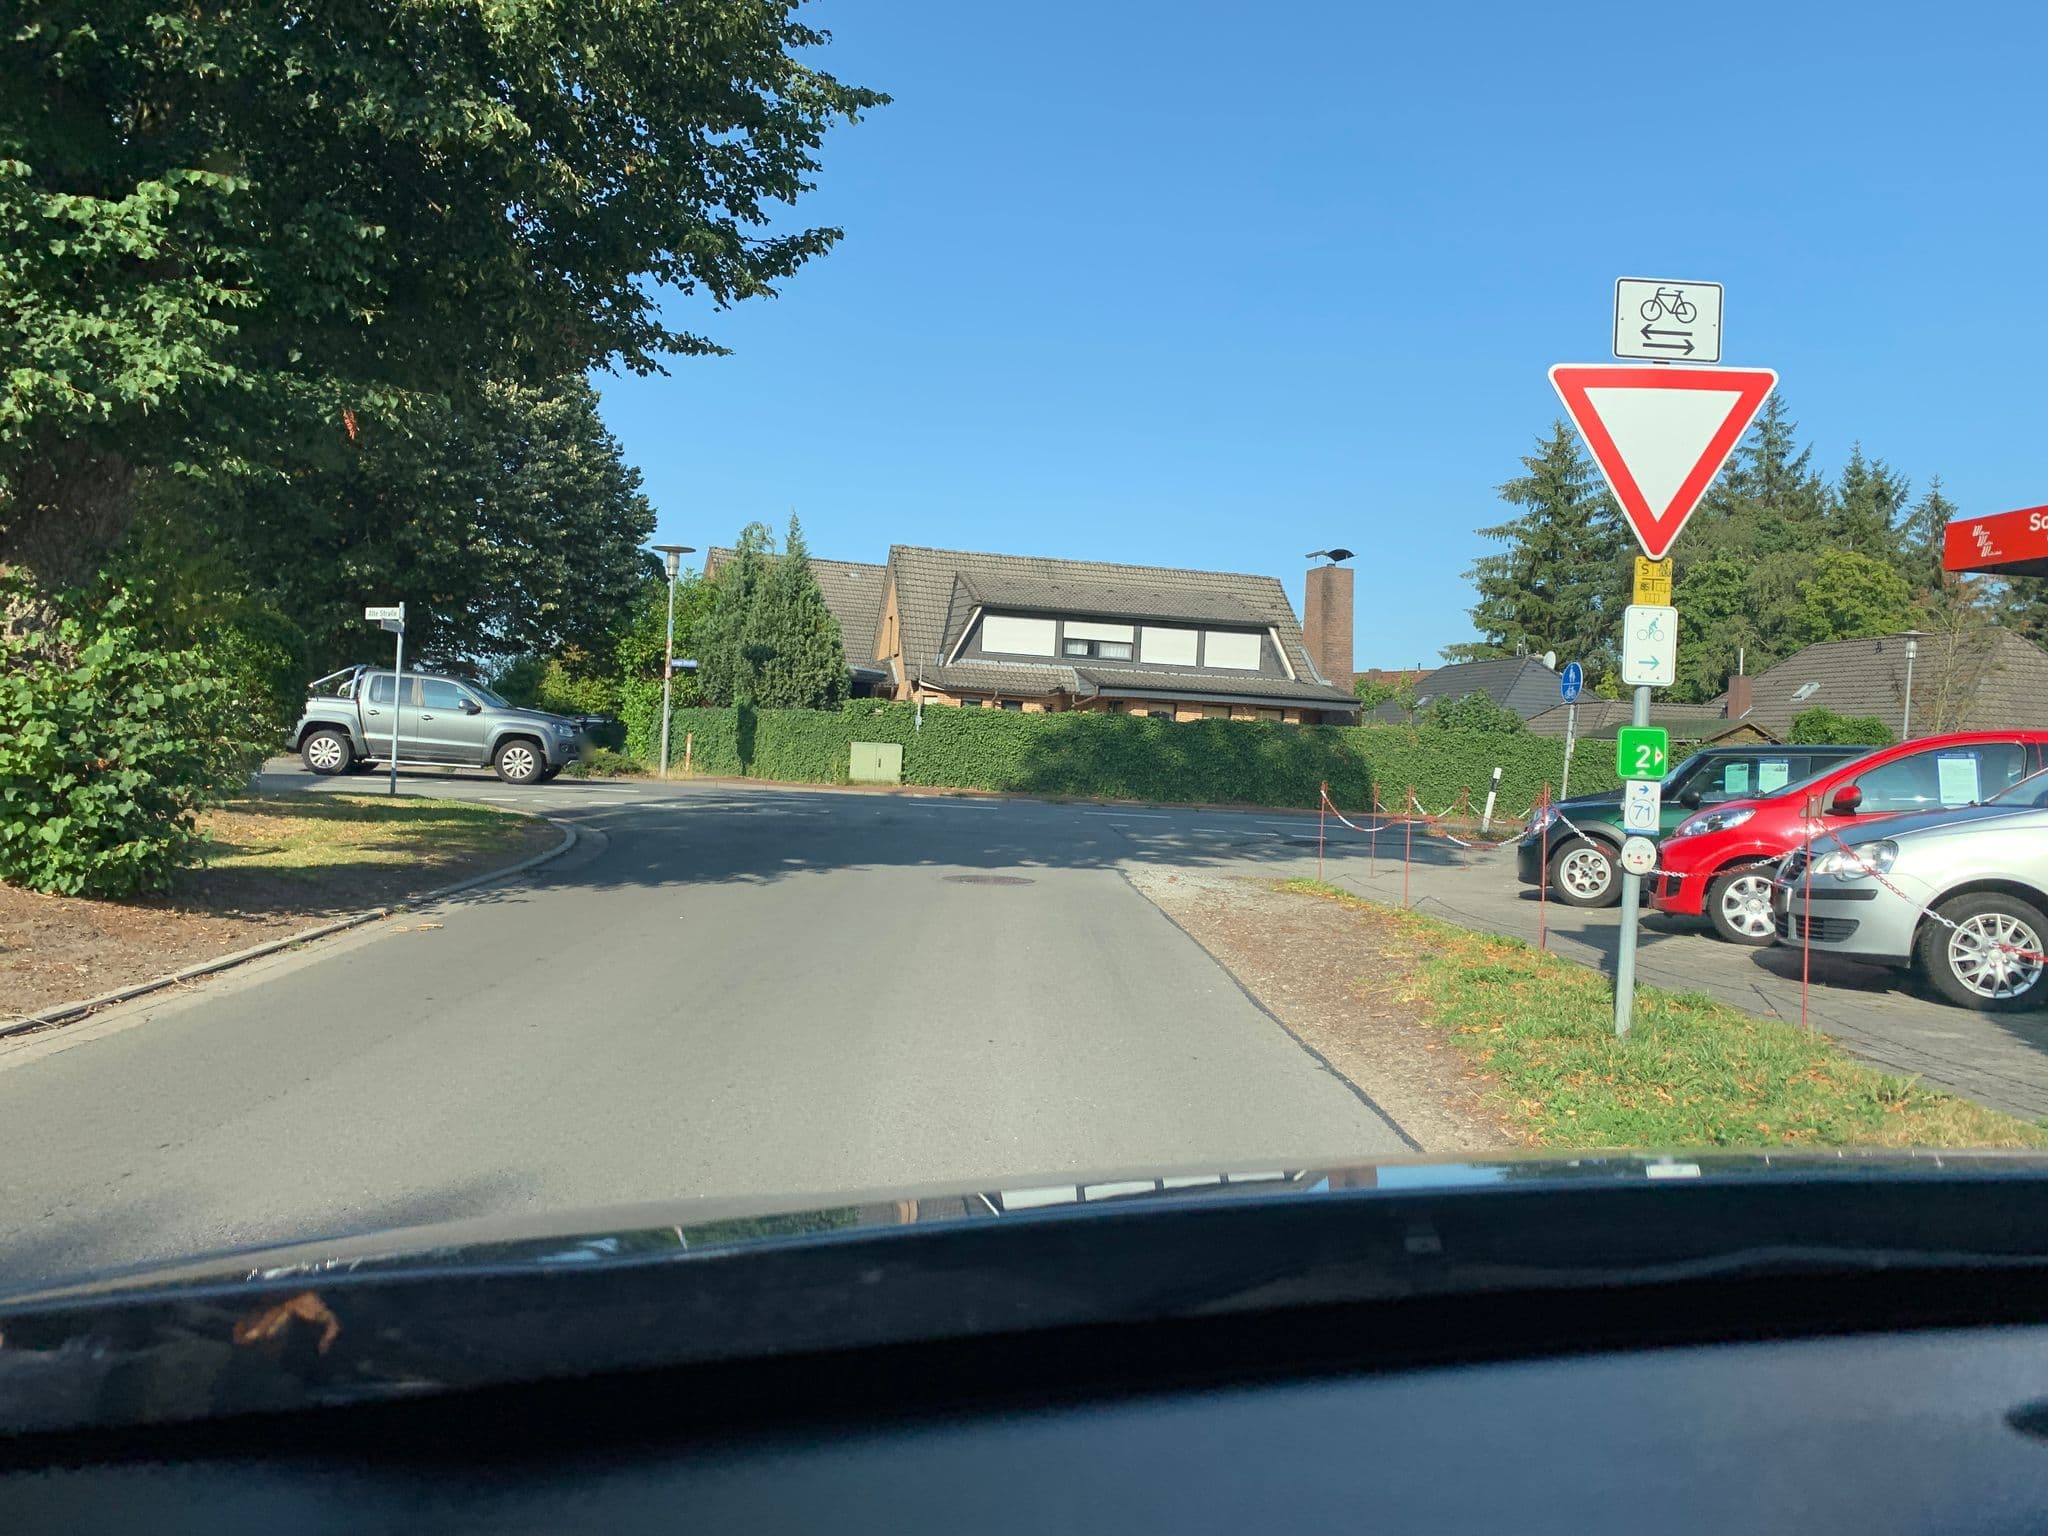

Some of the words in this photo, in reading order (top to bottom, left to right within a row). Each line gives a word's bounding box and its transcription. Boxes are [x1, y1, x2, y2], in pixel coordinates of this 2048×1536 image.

[1641, 563, 1649, 574] S
[1635, 745, 1650, 768] 2
[1634, 804, 1650, 821] 71
